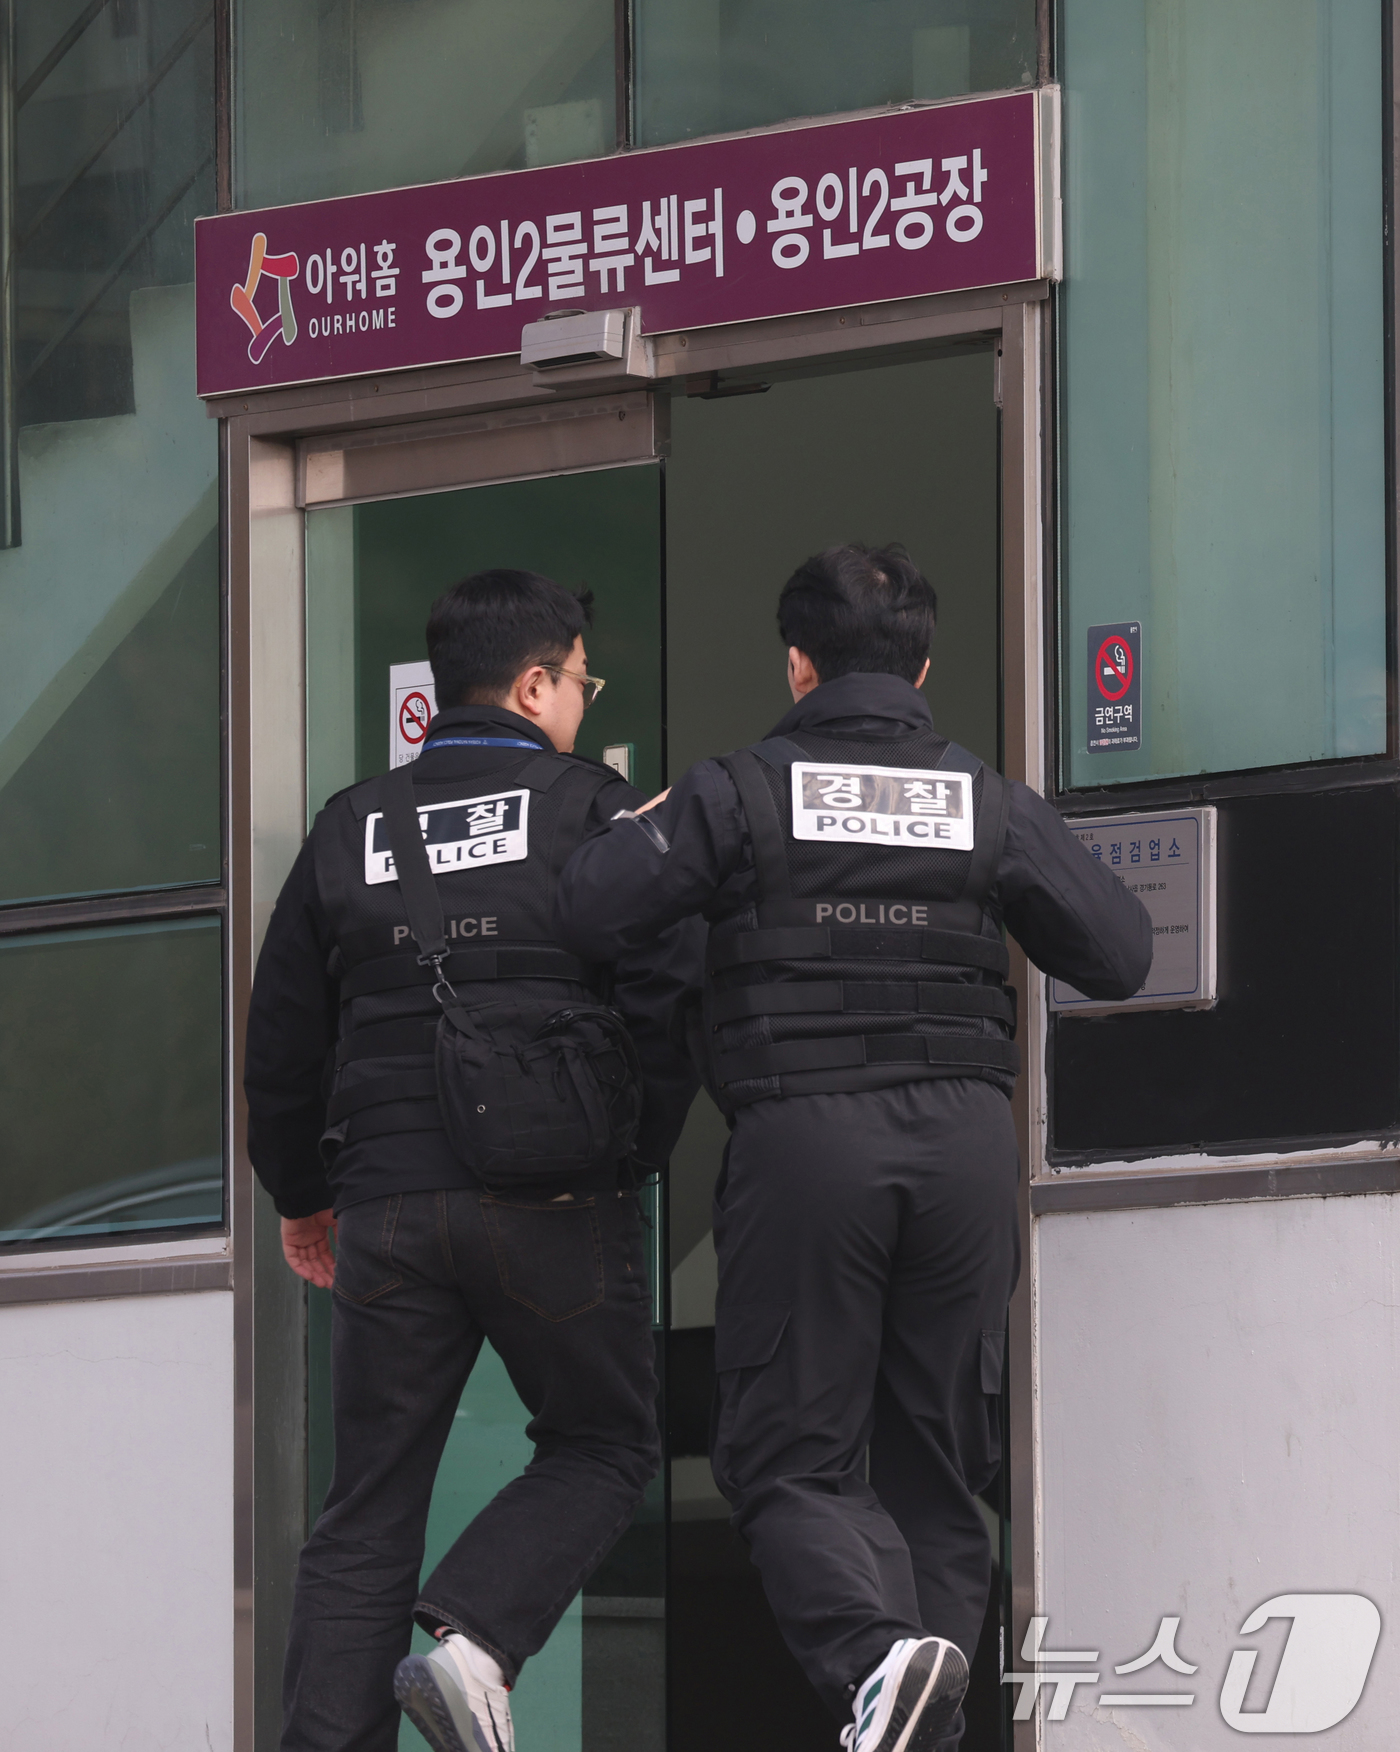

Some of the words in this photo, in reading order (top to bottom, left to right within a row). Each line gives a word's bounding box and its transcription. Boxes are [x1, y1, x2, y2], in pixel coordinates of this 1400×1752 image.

[305, 239, 400, 304] 아워홈
[308, 307, 397, 339] OURHOME
[1095, 704, 1133, 725] 금연구역
[816, 815, 952, 840] POLICE
[384, 837, 508, 873] PLICE
[816, 903, 929, 926] POLICE
[393, 916, 499, 945] PICE
